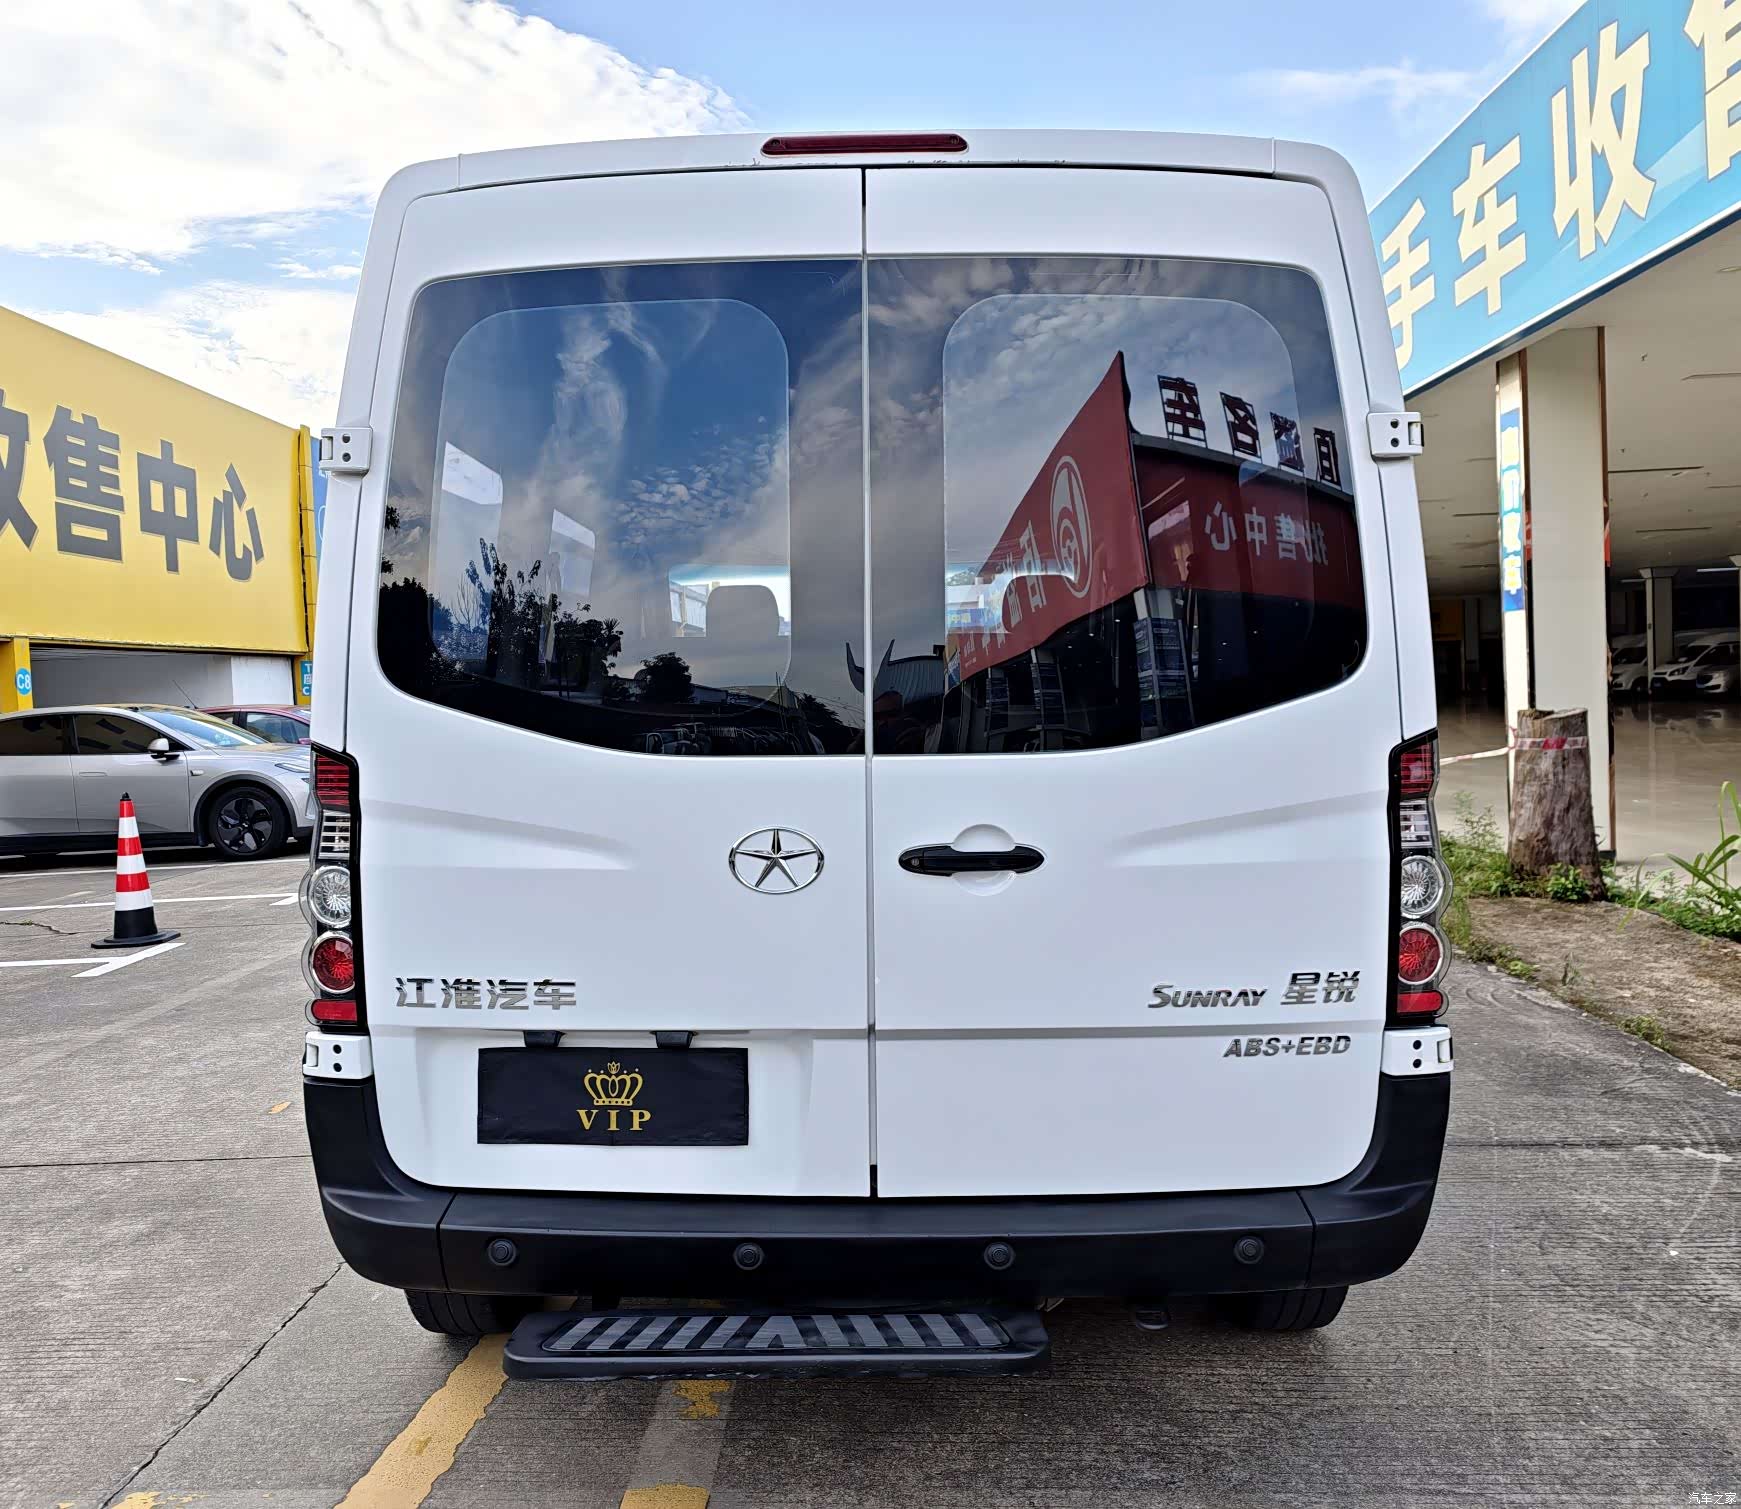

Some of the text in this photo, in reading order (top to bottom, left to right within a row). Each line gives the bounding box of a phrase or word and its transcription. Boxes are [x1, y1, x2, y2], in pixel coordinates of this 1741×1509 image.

[17, 673, 31, 690] C8
[395, 976, 577, 1011] 江淮汽车
[1148, 971, 1360, 1009] SUNRAY 星锐
[1223, 1035, 1352, 1058] ABS+EBD
[576, 1108, 652, 1132] VIP
